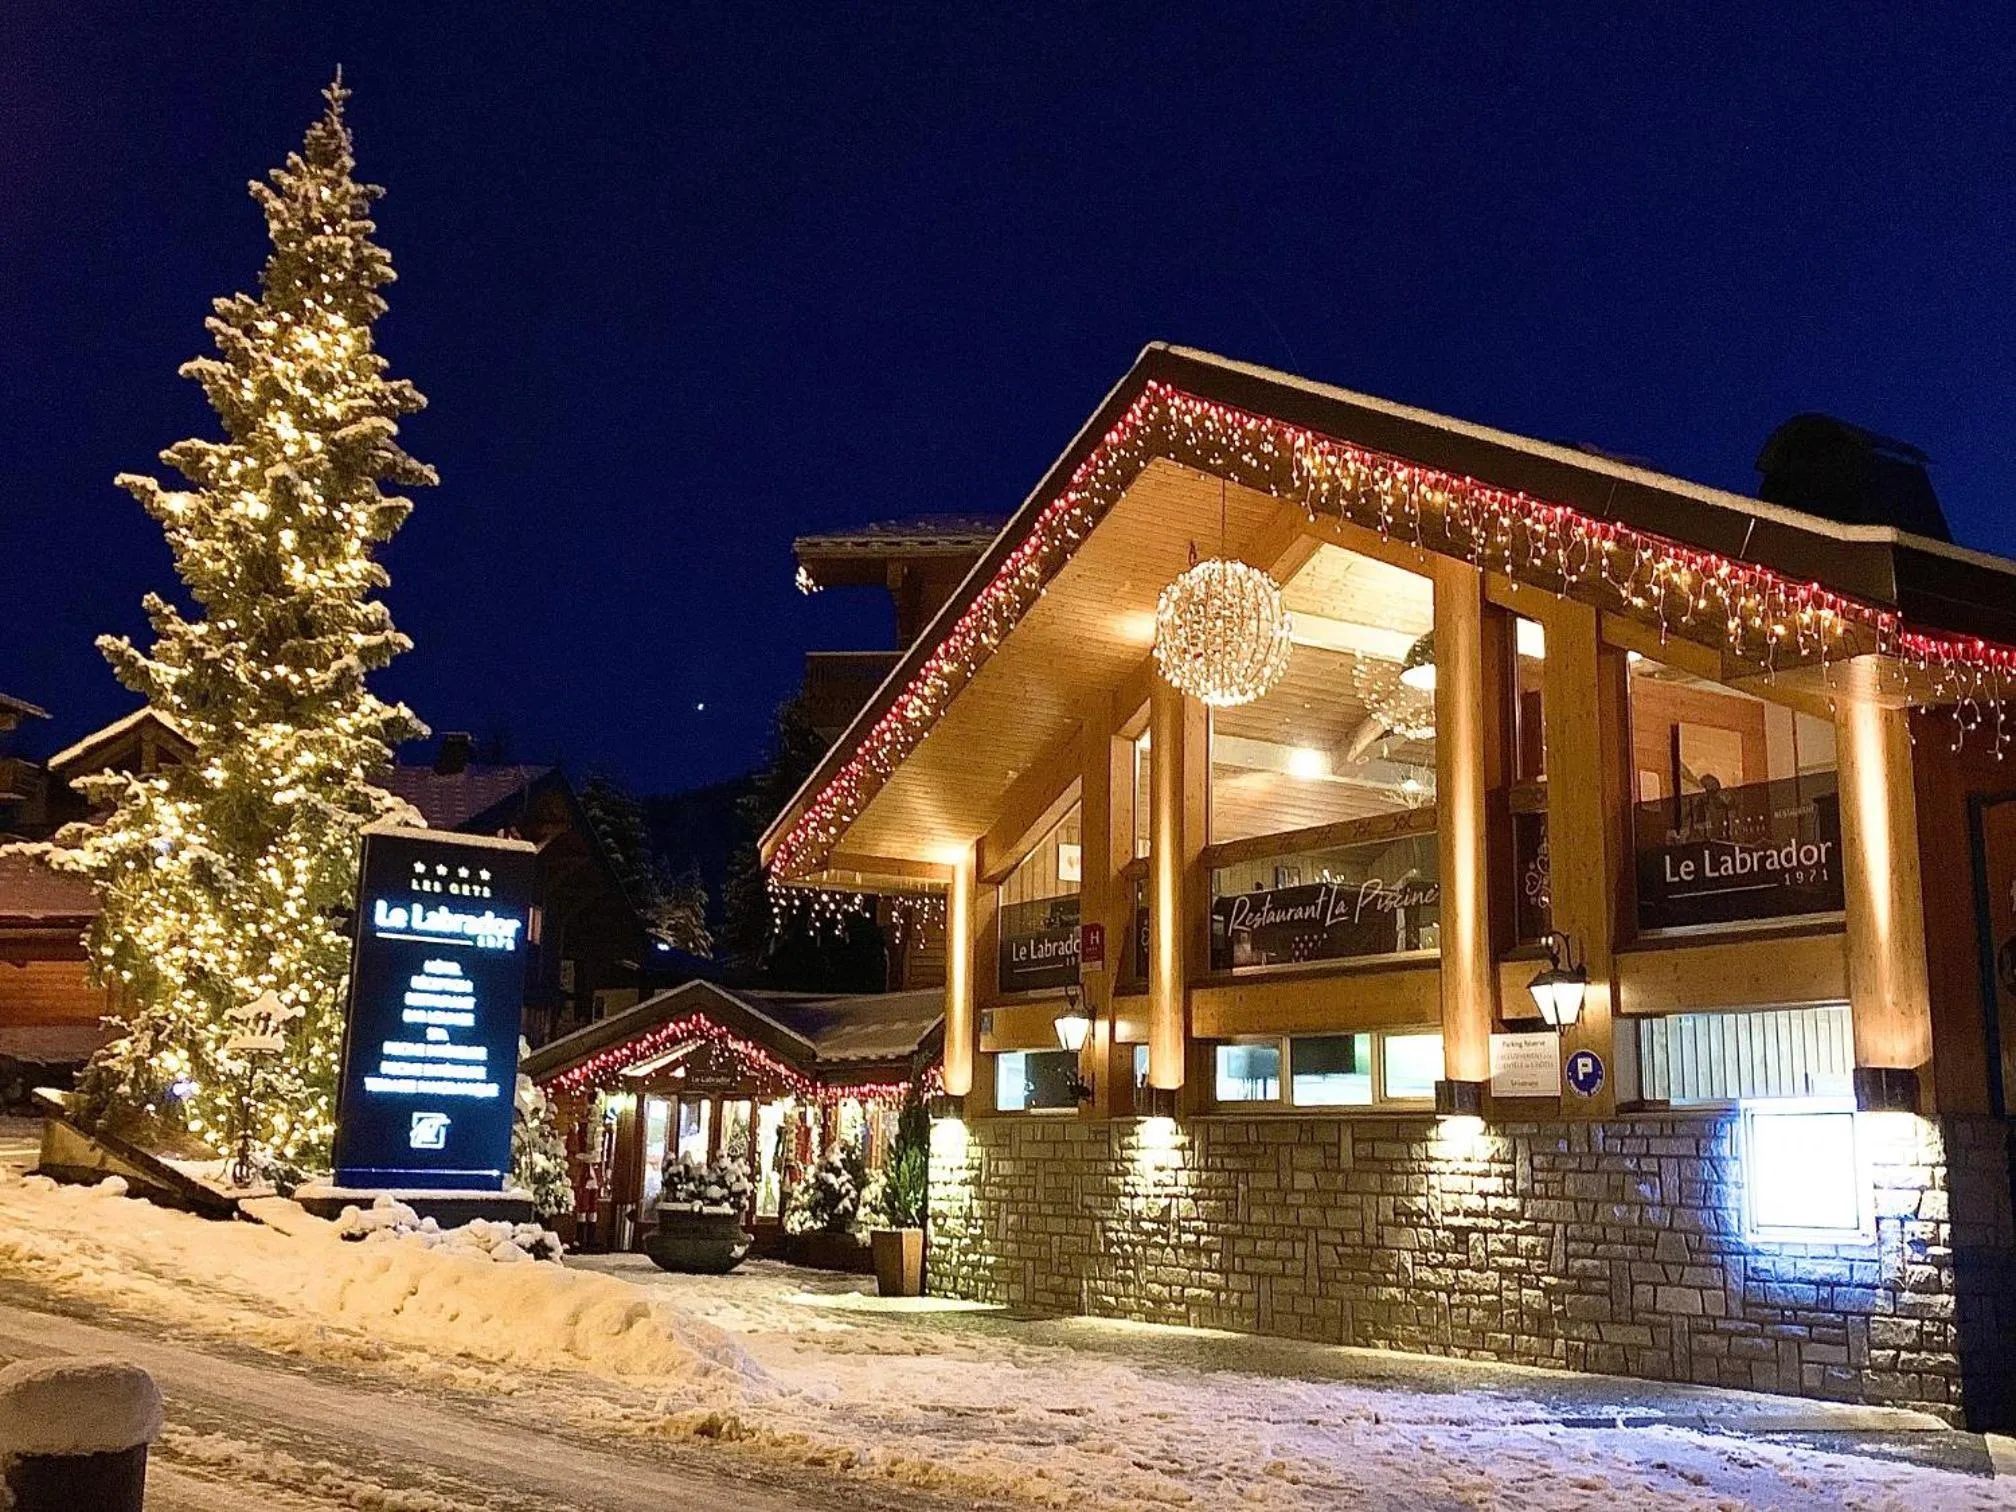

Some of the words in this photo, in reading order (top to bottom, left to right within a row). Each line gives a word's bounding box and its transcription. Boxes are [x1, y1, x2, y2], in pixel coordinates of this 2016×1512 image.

[1664, 854, 1695, 883] Le
[1704, 838, 1832, 878] Labrador
[411, 878, 442, 893] LES
[449, 882, 492, 898] GETS
[1784, 869, 1829, 886] 1971
[374, 898, 409, 929] Le
[411, 902, 522, 938] Labrador
[1228, 886, 1329, 937] Restaurant
[1325, 885, 1350, 927] La
[1355, 878, 1440, 924] Piscine
[1012, 942, 1028, 962] Le
[1030, 933, 1081, 960] Labrado
[1090, 929, 1100, 945] H
[1577, 1057, 1593, 1080] P
